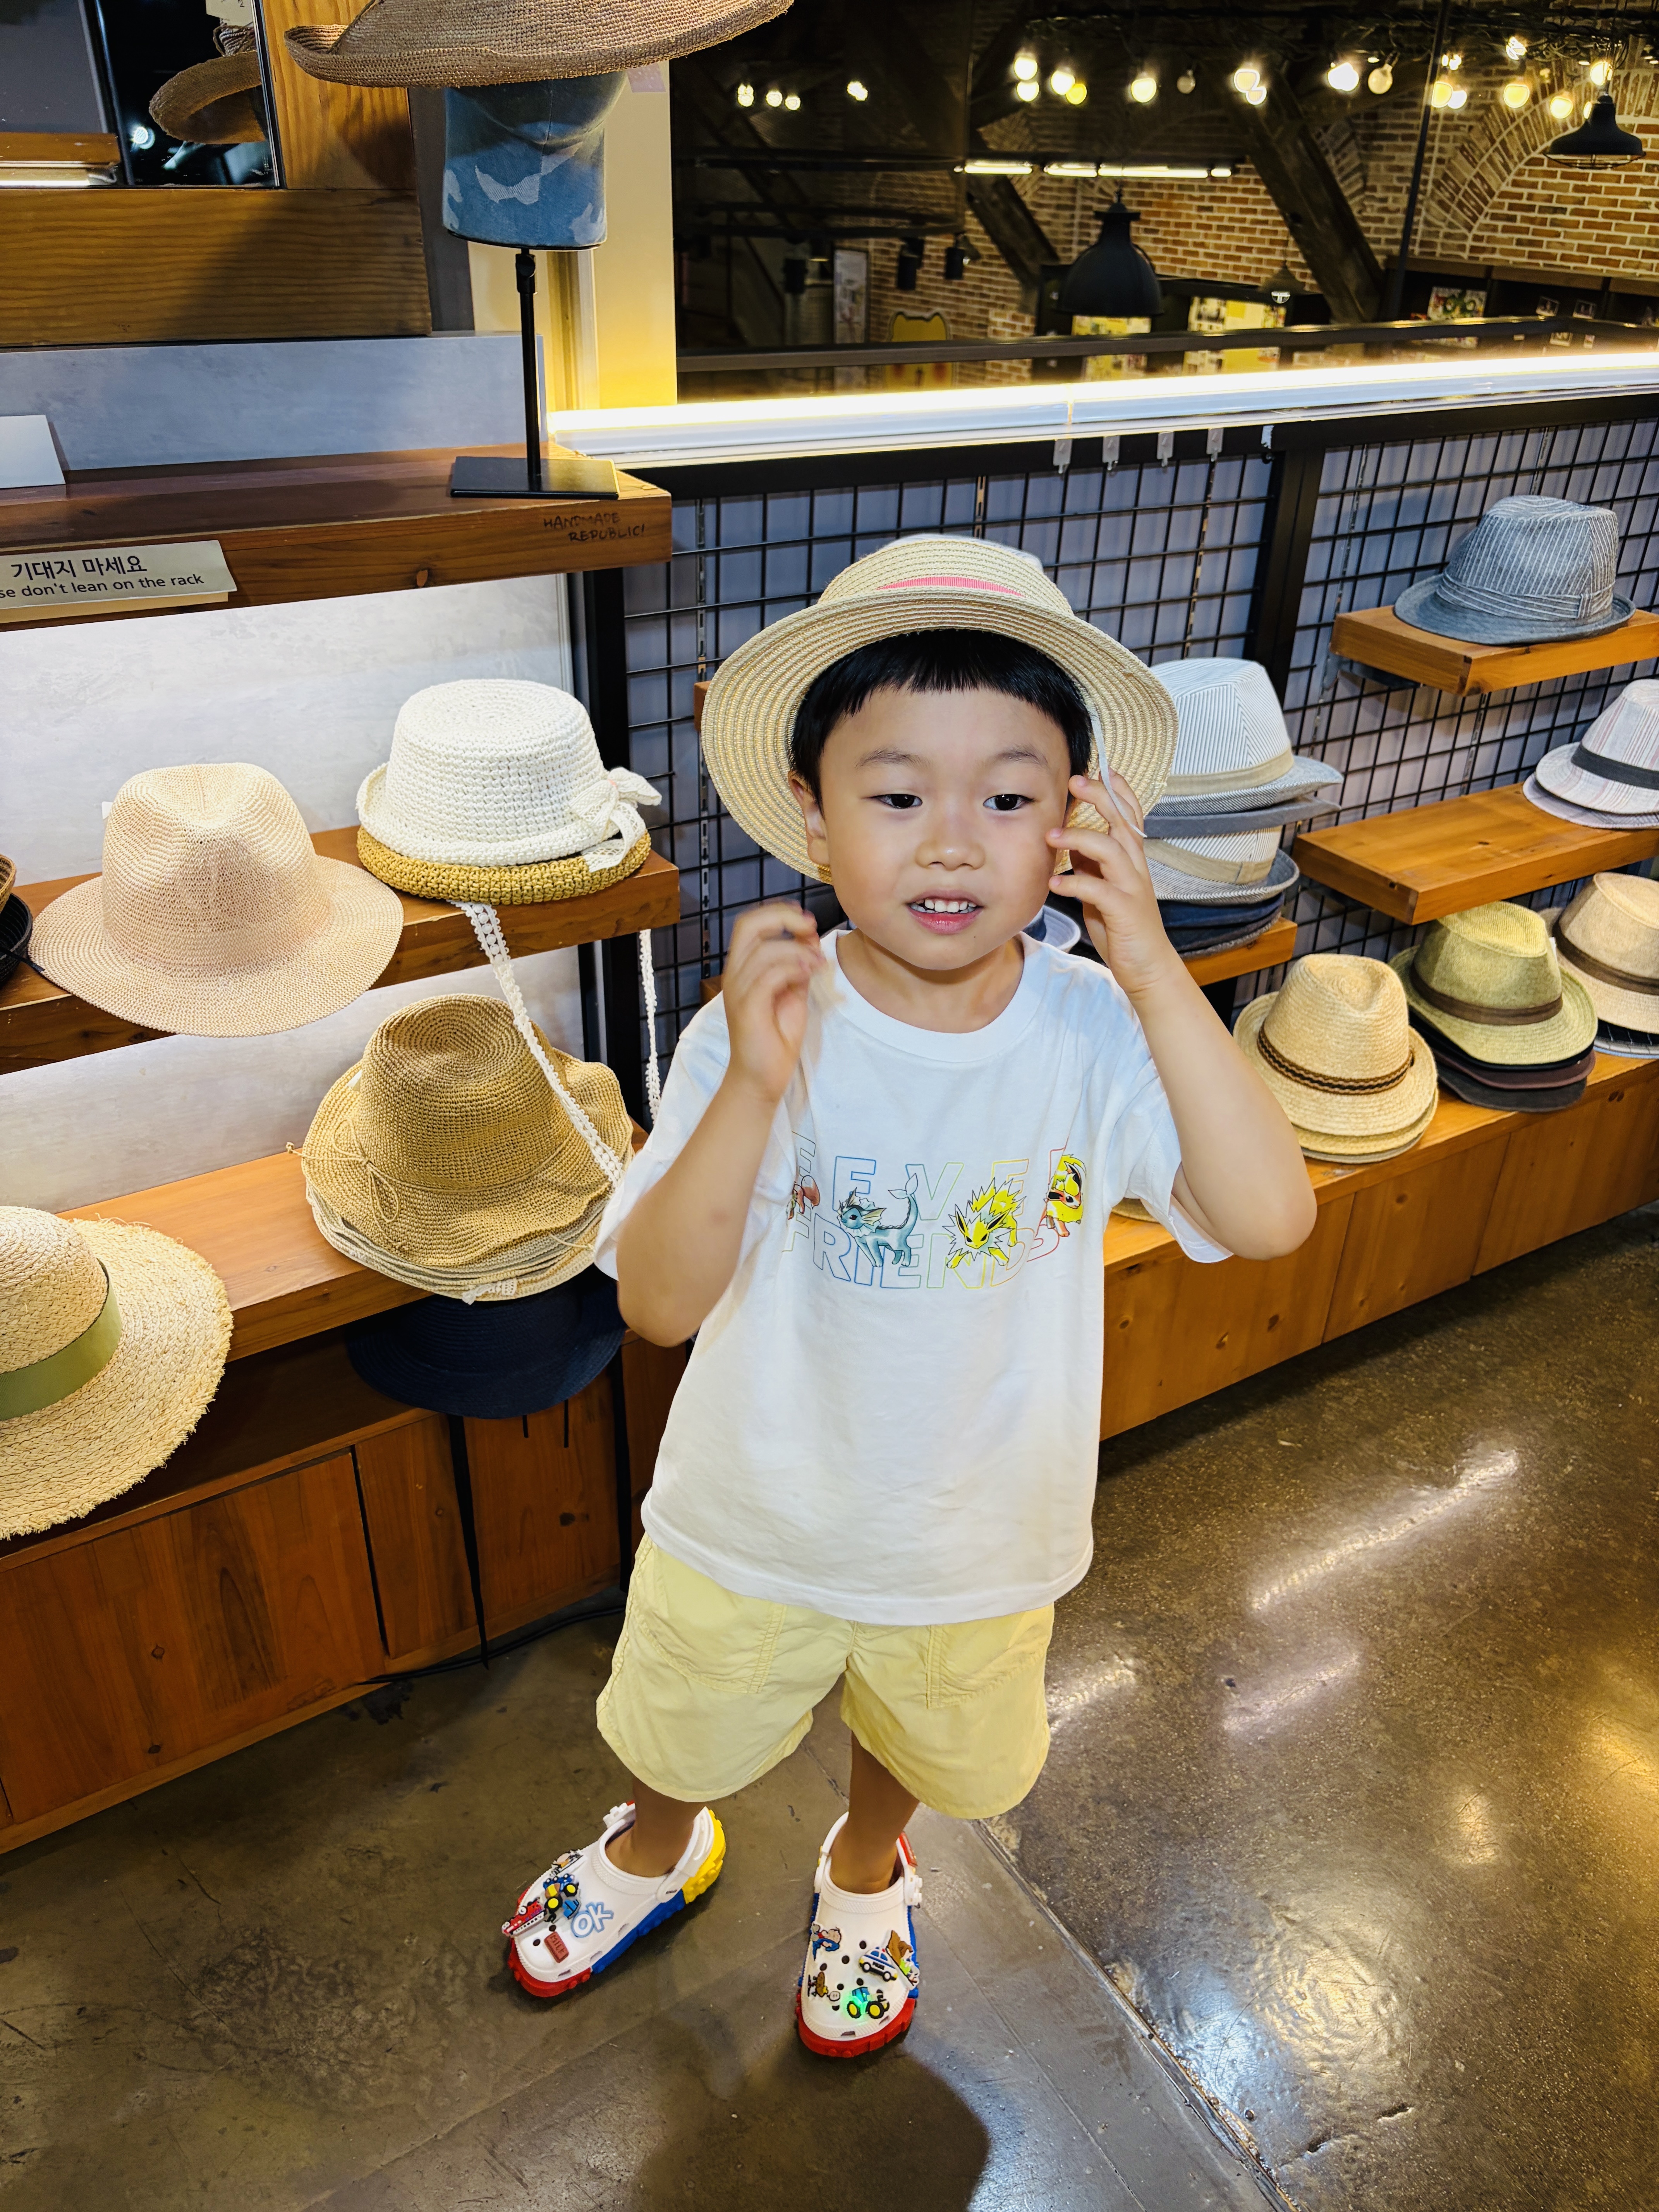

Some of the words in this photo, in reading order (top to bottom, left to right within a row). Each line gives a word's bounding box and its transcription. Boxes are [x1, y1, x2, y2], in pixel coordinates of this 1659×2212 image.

[543, 512, 620, 529] HANDMADE
[568, 524, 645, 541] REPUBLIC!
[10, 559, 77, 580] 기대지
[82, 555, 148, 576] 마세요
[21, 582, 69, 597] don't
[72, 582, 108, 593] lean
[113, 581, 134, 590] on
[138, 577, 166, 588] the
[170, 574, 205, 586] rack
[571, 1902, 614, 1938] OK
